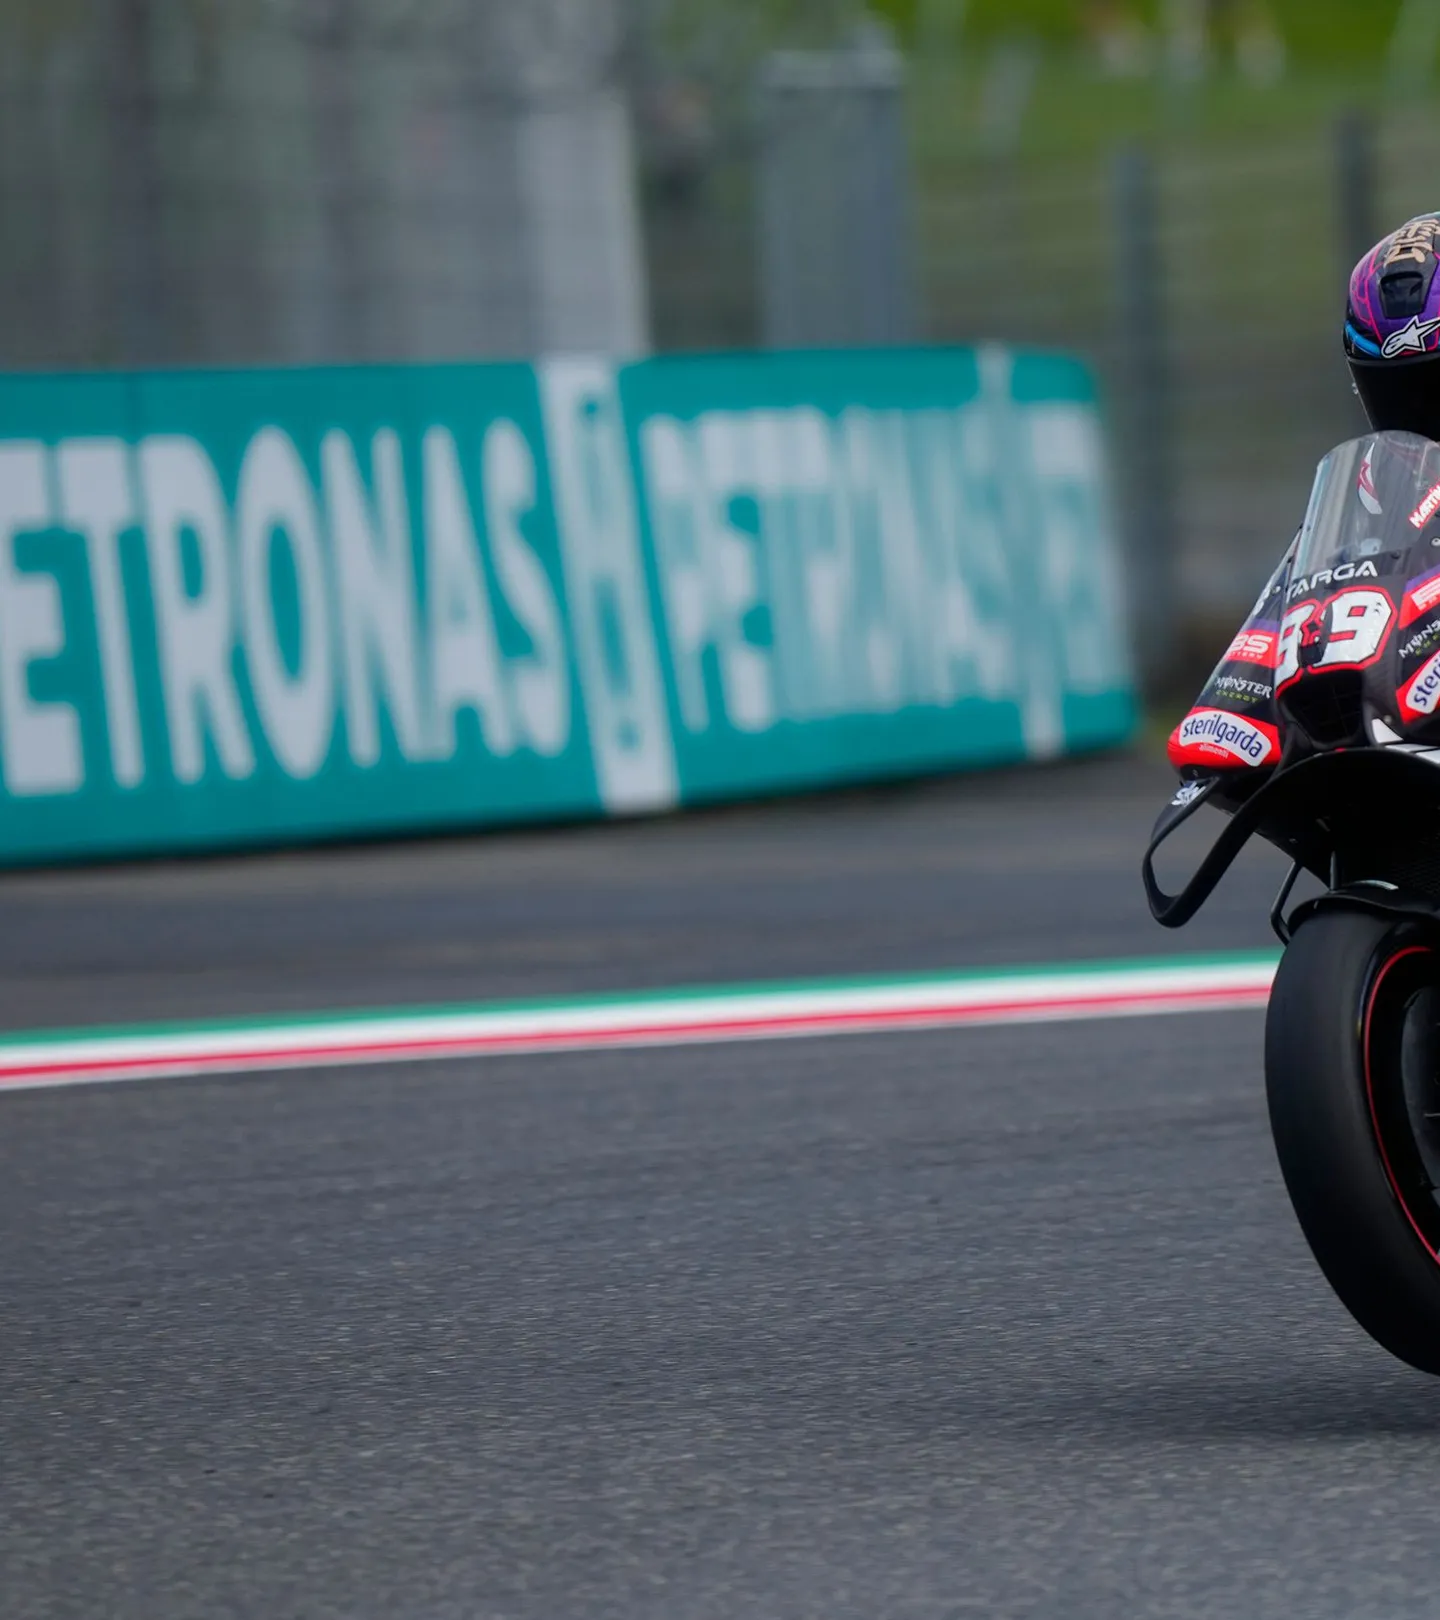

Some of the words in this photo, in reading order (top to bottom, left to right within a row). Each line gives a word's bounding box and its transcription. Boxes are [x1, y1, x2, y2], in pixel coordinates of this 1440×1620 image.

[1286, 561, 1378, 603] TARGA
[1215, 675, 1273, 699] MONSTER
[1182, 714, 1263, 758] sterilgarda
